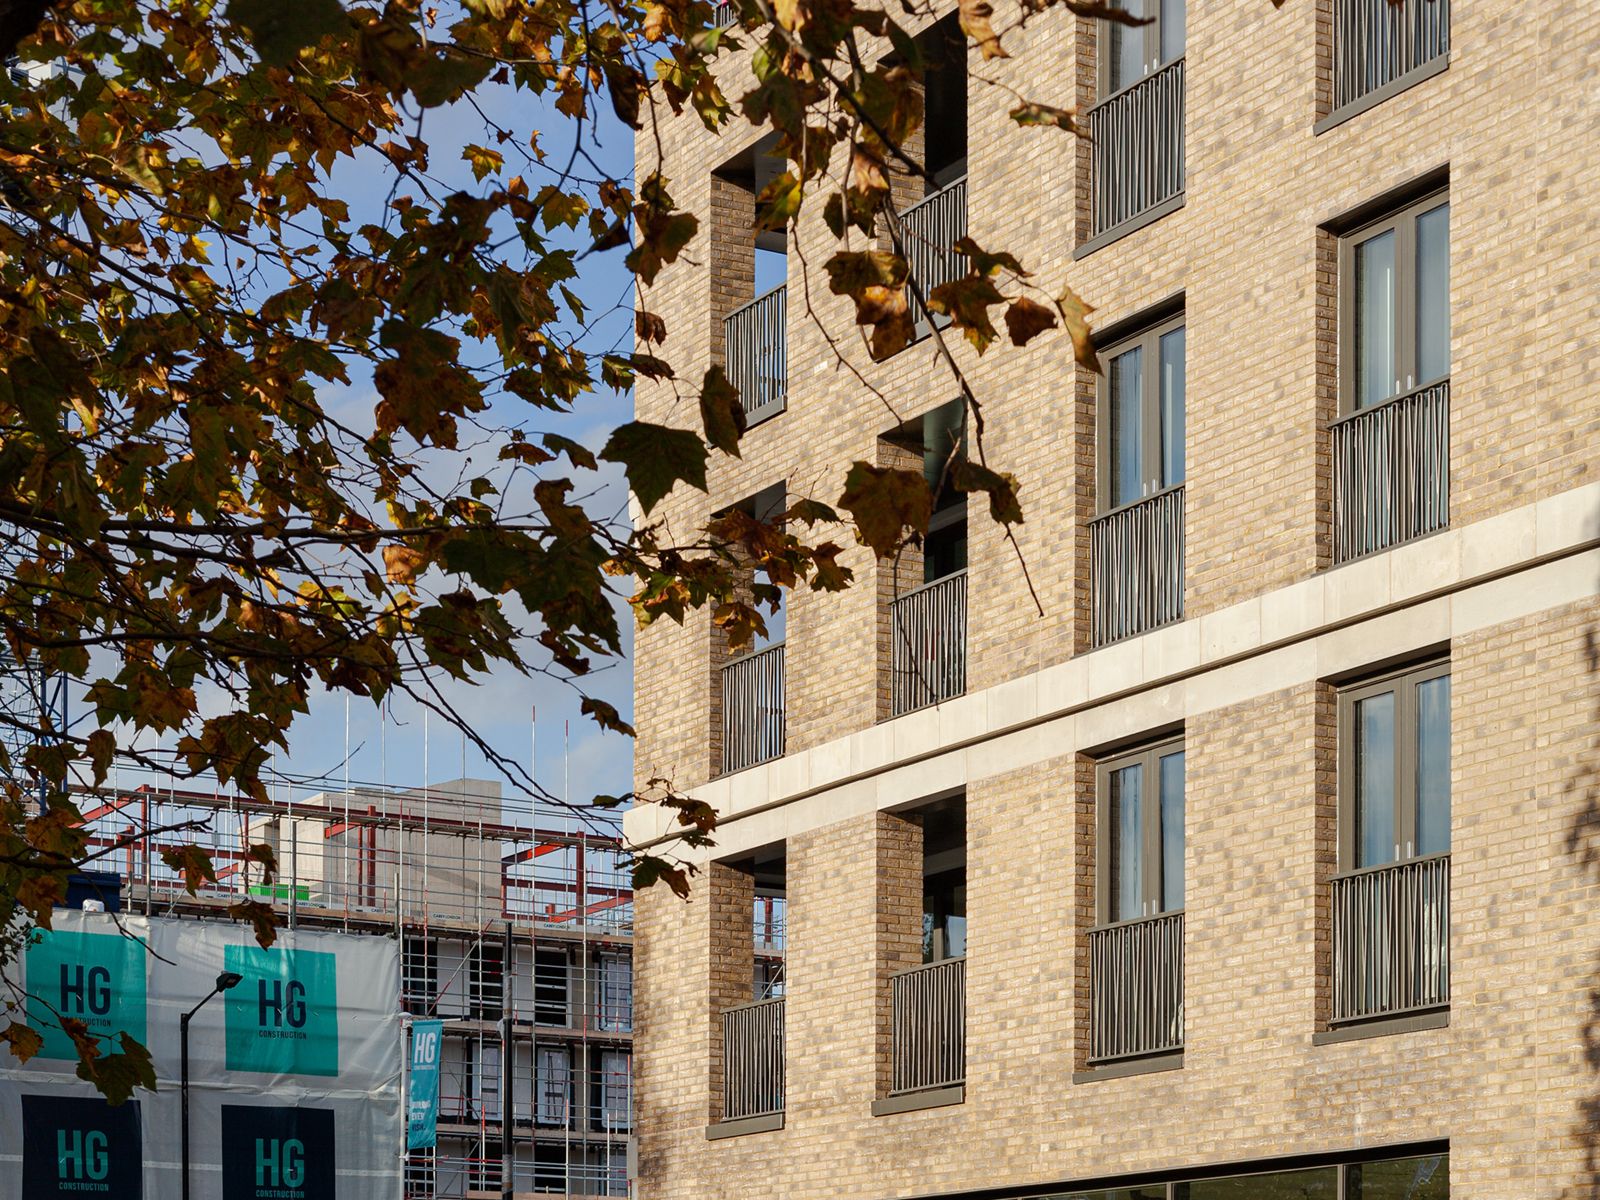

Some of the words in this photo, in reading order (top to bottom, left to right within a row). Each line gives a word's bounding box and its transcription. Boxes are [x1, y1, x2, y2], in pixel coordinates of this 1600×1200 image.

[60, 963, 111, 1016] HG
[258, 979, 307, 1028] HG
[258, 1030, 307, 1040] CONSTRUCTION
[414, 1032, 436, 1063] HG
[57, 1129, 108, 1180] HG
[255, 1138, 304, 1188] HG
[58, 1181, 109, 1192] CONSTRUCTION
[255, 1189, 304, 1199] CONSTRUCTION
